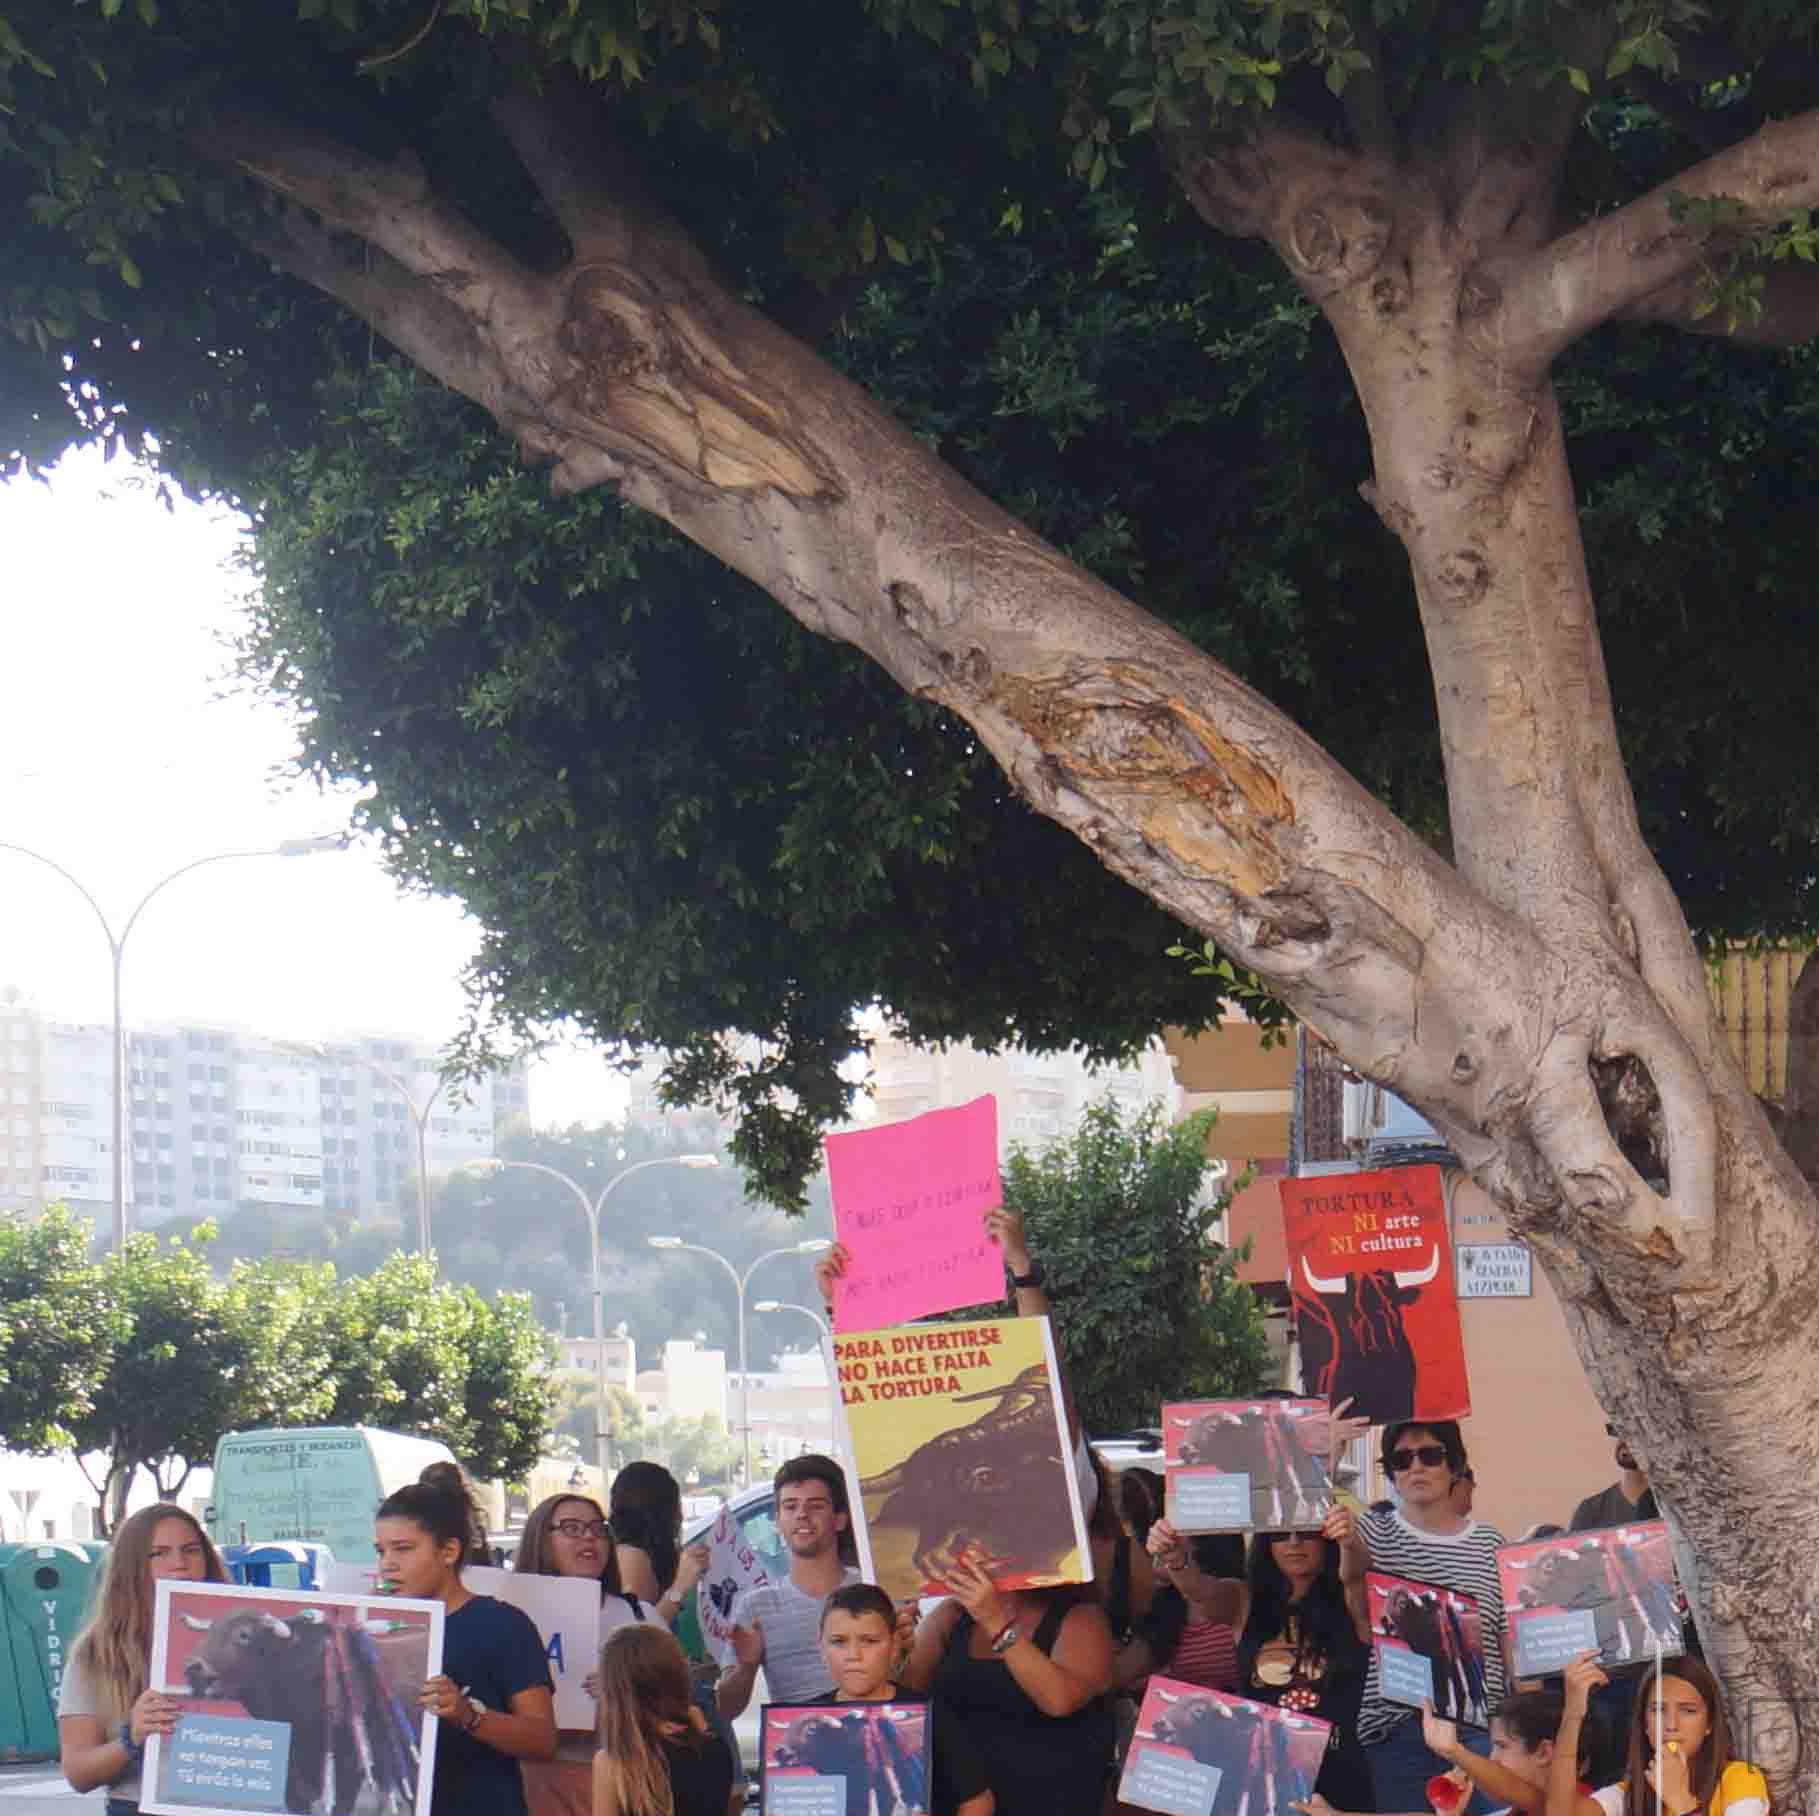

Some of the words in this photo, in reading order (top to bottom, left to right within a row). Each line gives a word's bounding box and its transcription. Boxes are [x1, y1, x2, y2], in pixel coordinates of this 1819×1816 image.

[1303, 1191, 1416, 1217] TORTURA
[1353, 1213, 1378, 1233] NI
[1384, 1213, 1421, 1230] arte
[1329, 1235, 1355, 1255] NI
[1360, 1234, 1424, 1252] cultura
[833, 1338, 886, 1362] PARA
[891, 1326, 1003, 1354] DIVERTIRSE
[838, 1363, 869, 1383] NO
[875, 1357, 928, 1379] HACE
[933, 1350, 992, 1372] FALTA
[840, 1385, 865, 1405] LA
[867, 1375, 963, 1402] TORTURA
